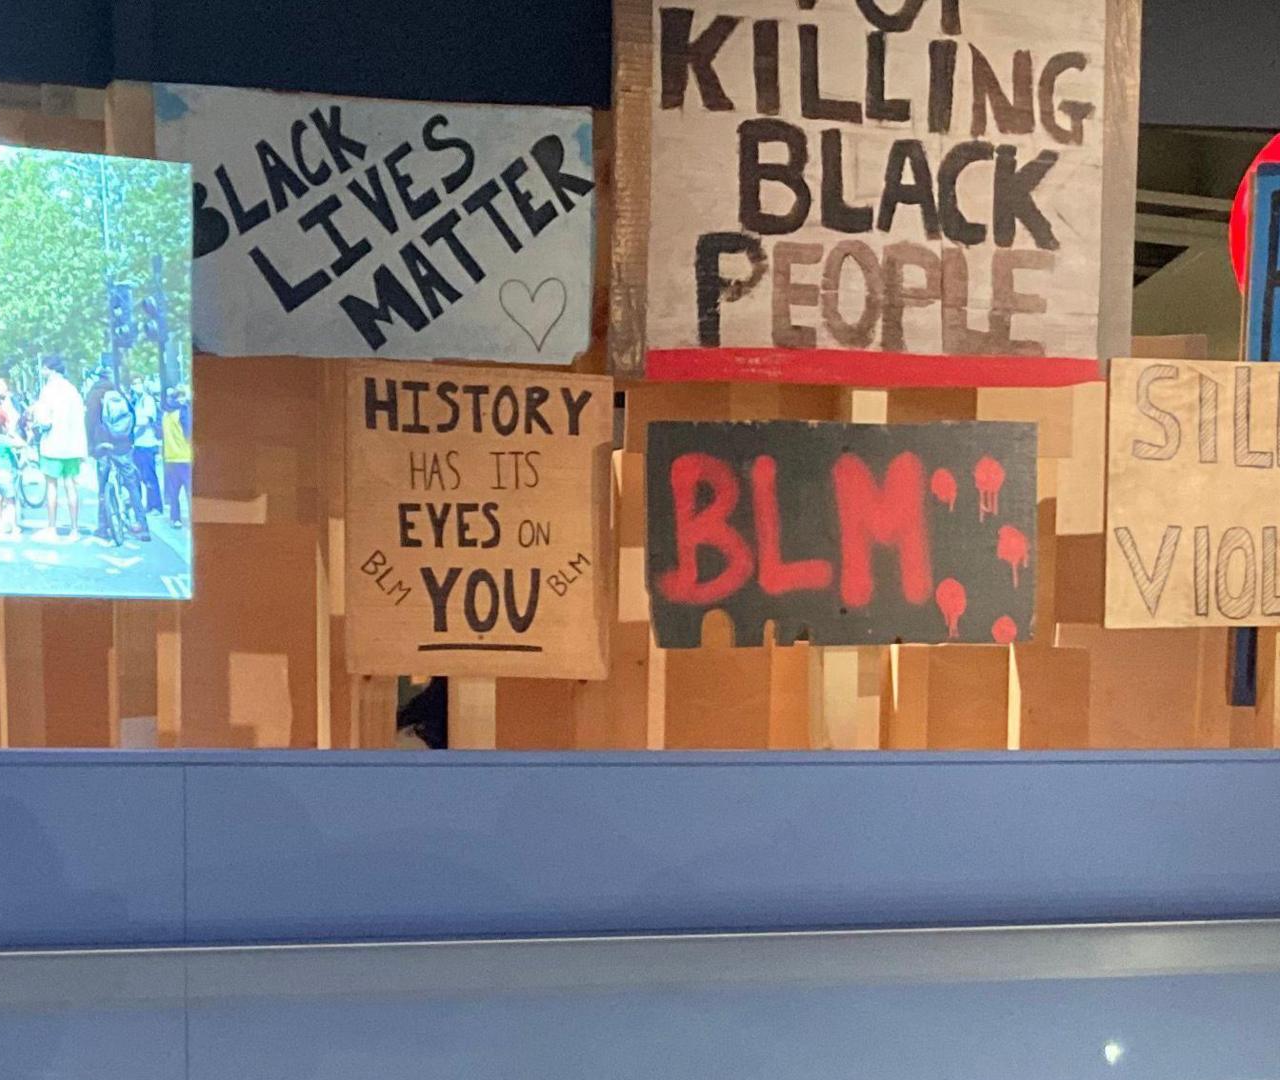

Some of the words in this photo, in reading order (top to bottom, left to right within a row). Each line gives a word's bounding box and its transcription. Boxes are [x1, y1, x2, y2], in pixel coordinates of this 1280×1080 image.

[659, 6, 1096, 146] KILLING
[193, 105, 367, 259] BLACK
[248, 113, 475, 313] LIVES
[338, 134, 595, 351] MATTER
[736, 117, 1062, 250] BLACK
[694, 231, 1056, 357] PEOPLE
[364, 377, 593, 436] HISTORY
[397, 502, 501, 549] EYES
[518, 519, 551, 548] ON
[409, 450, 462, 491] HAS
[489, 451, 541, 490] ITS
[659, 451, 933, 608] BLM
[360, 550, 413, 606] BLM
[419, 566, 541, 634] YOU
[546, 552, 592, 597] BLM
